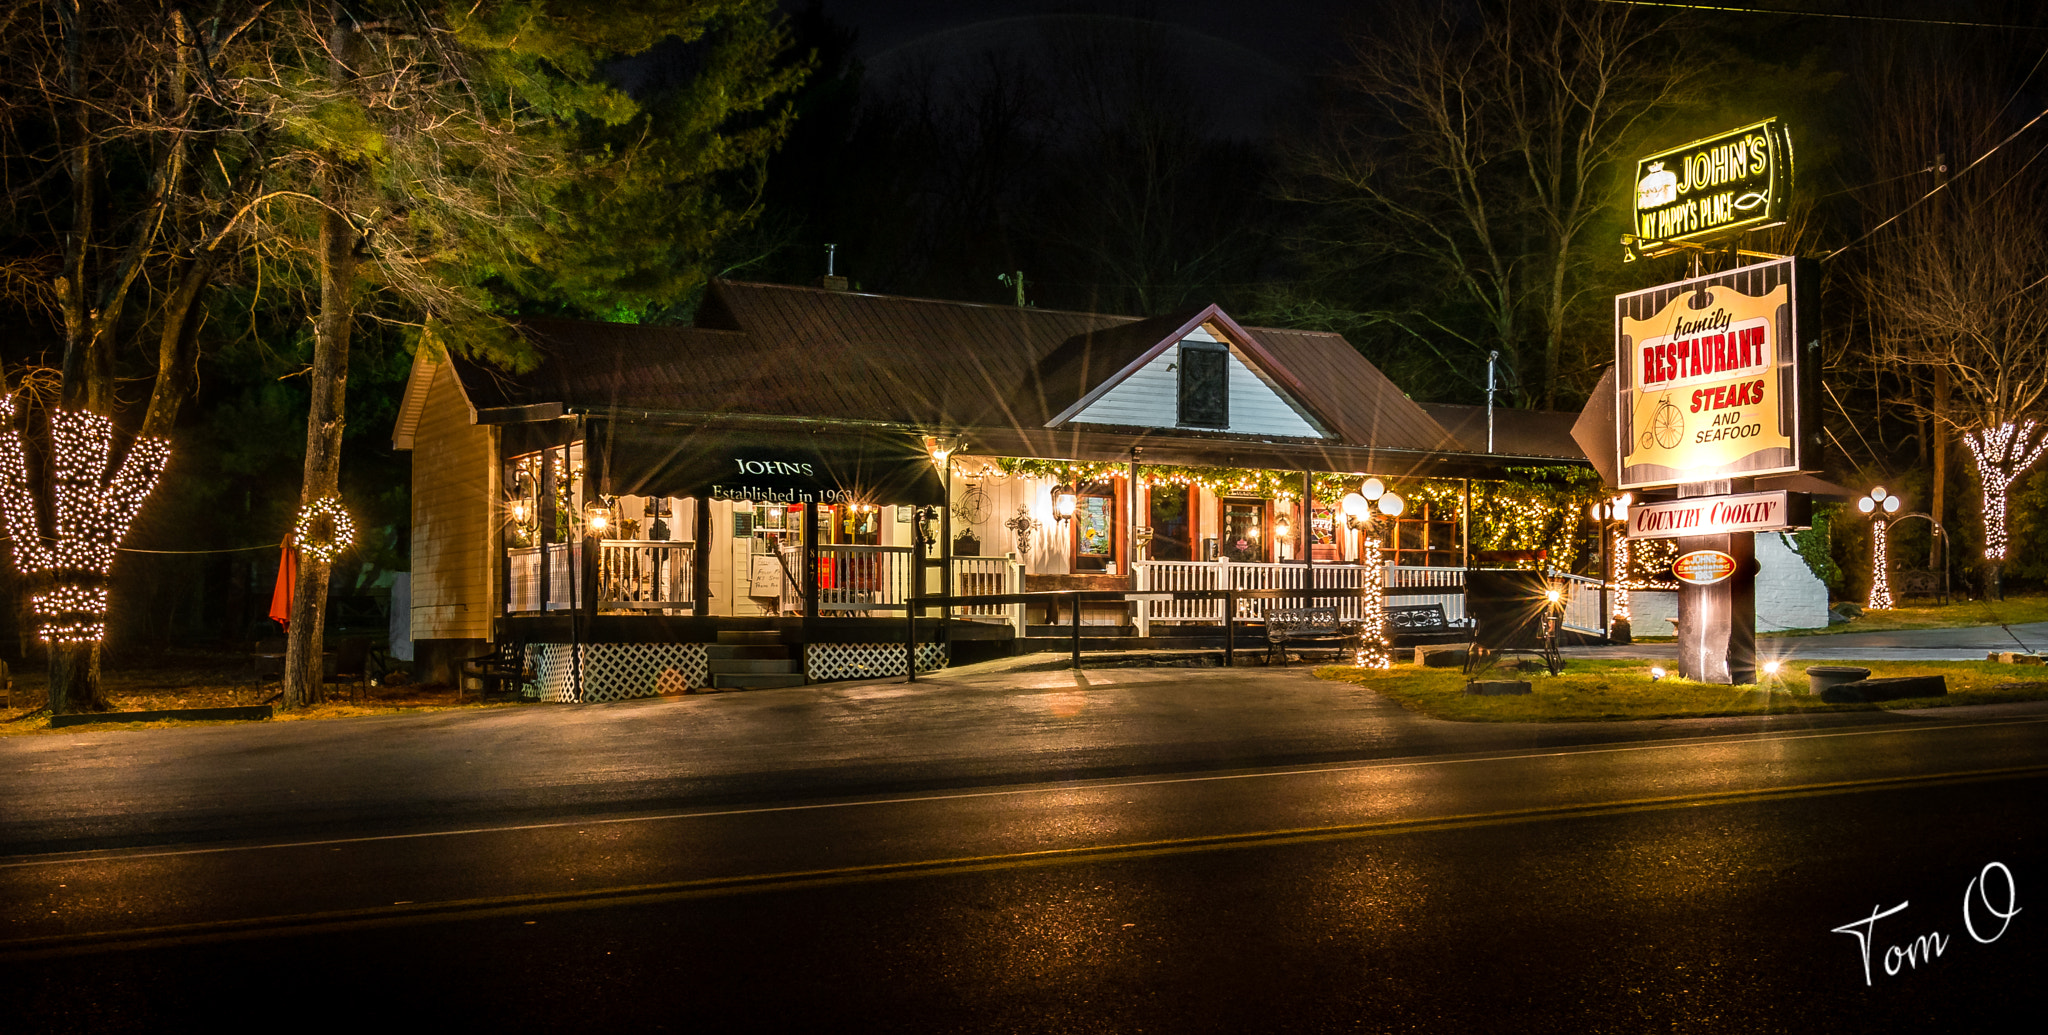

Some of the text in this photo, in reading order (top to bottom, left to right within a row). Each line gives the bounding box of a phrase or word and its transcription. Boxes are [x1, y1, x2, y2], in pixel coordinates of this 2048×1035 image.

[1676, 134, 1767, 194] JOHN'S
[1641, 191, 1735, 239] MY PAPPY'S PLACE
[1673, 308, 1732, 340] family
[1643, 326, 1765, 384] RESTAURANT
[1690, 380, 1765, 413] STEAKS
[1712, 411, 1740, 427] AND
[1695, 424, 1761, 443] SEAFOOD
[735, 458, 814, 477] JOHNS
[712, 484, 794, 502] Established
[799, 489, 813, 503] in
[1637, 507, 1705, 532] COUNTRY
